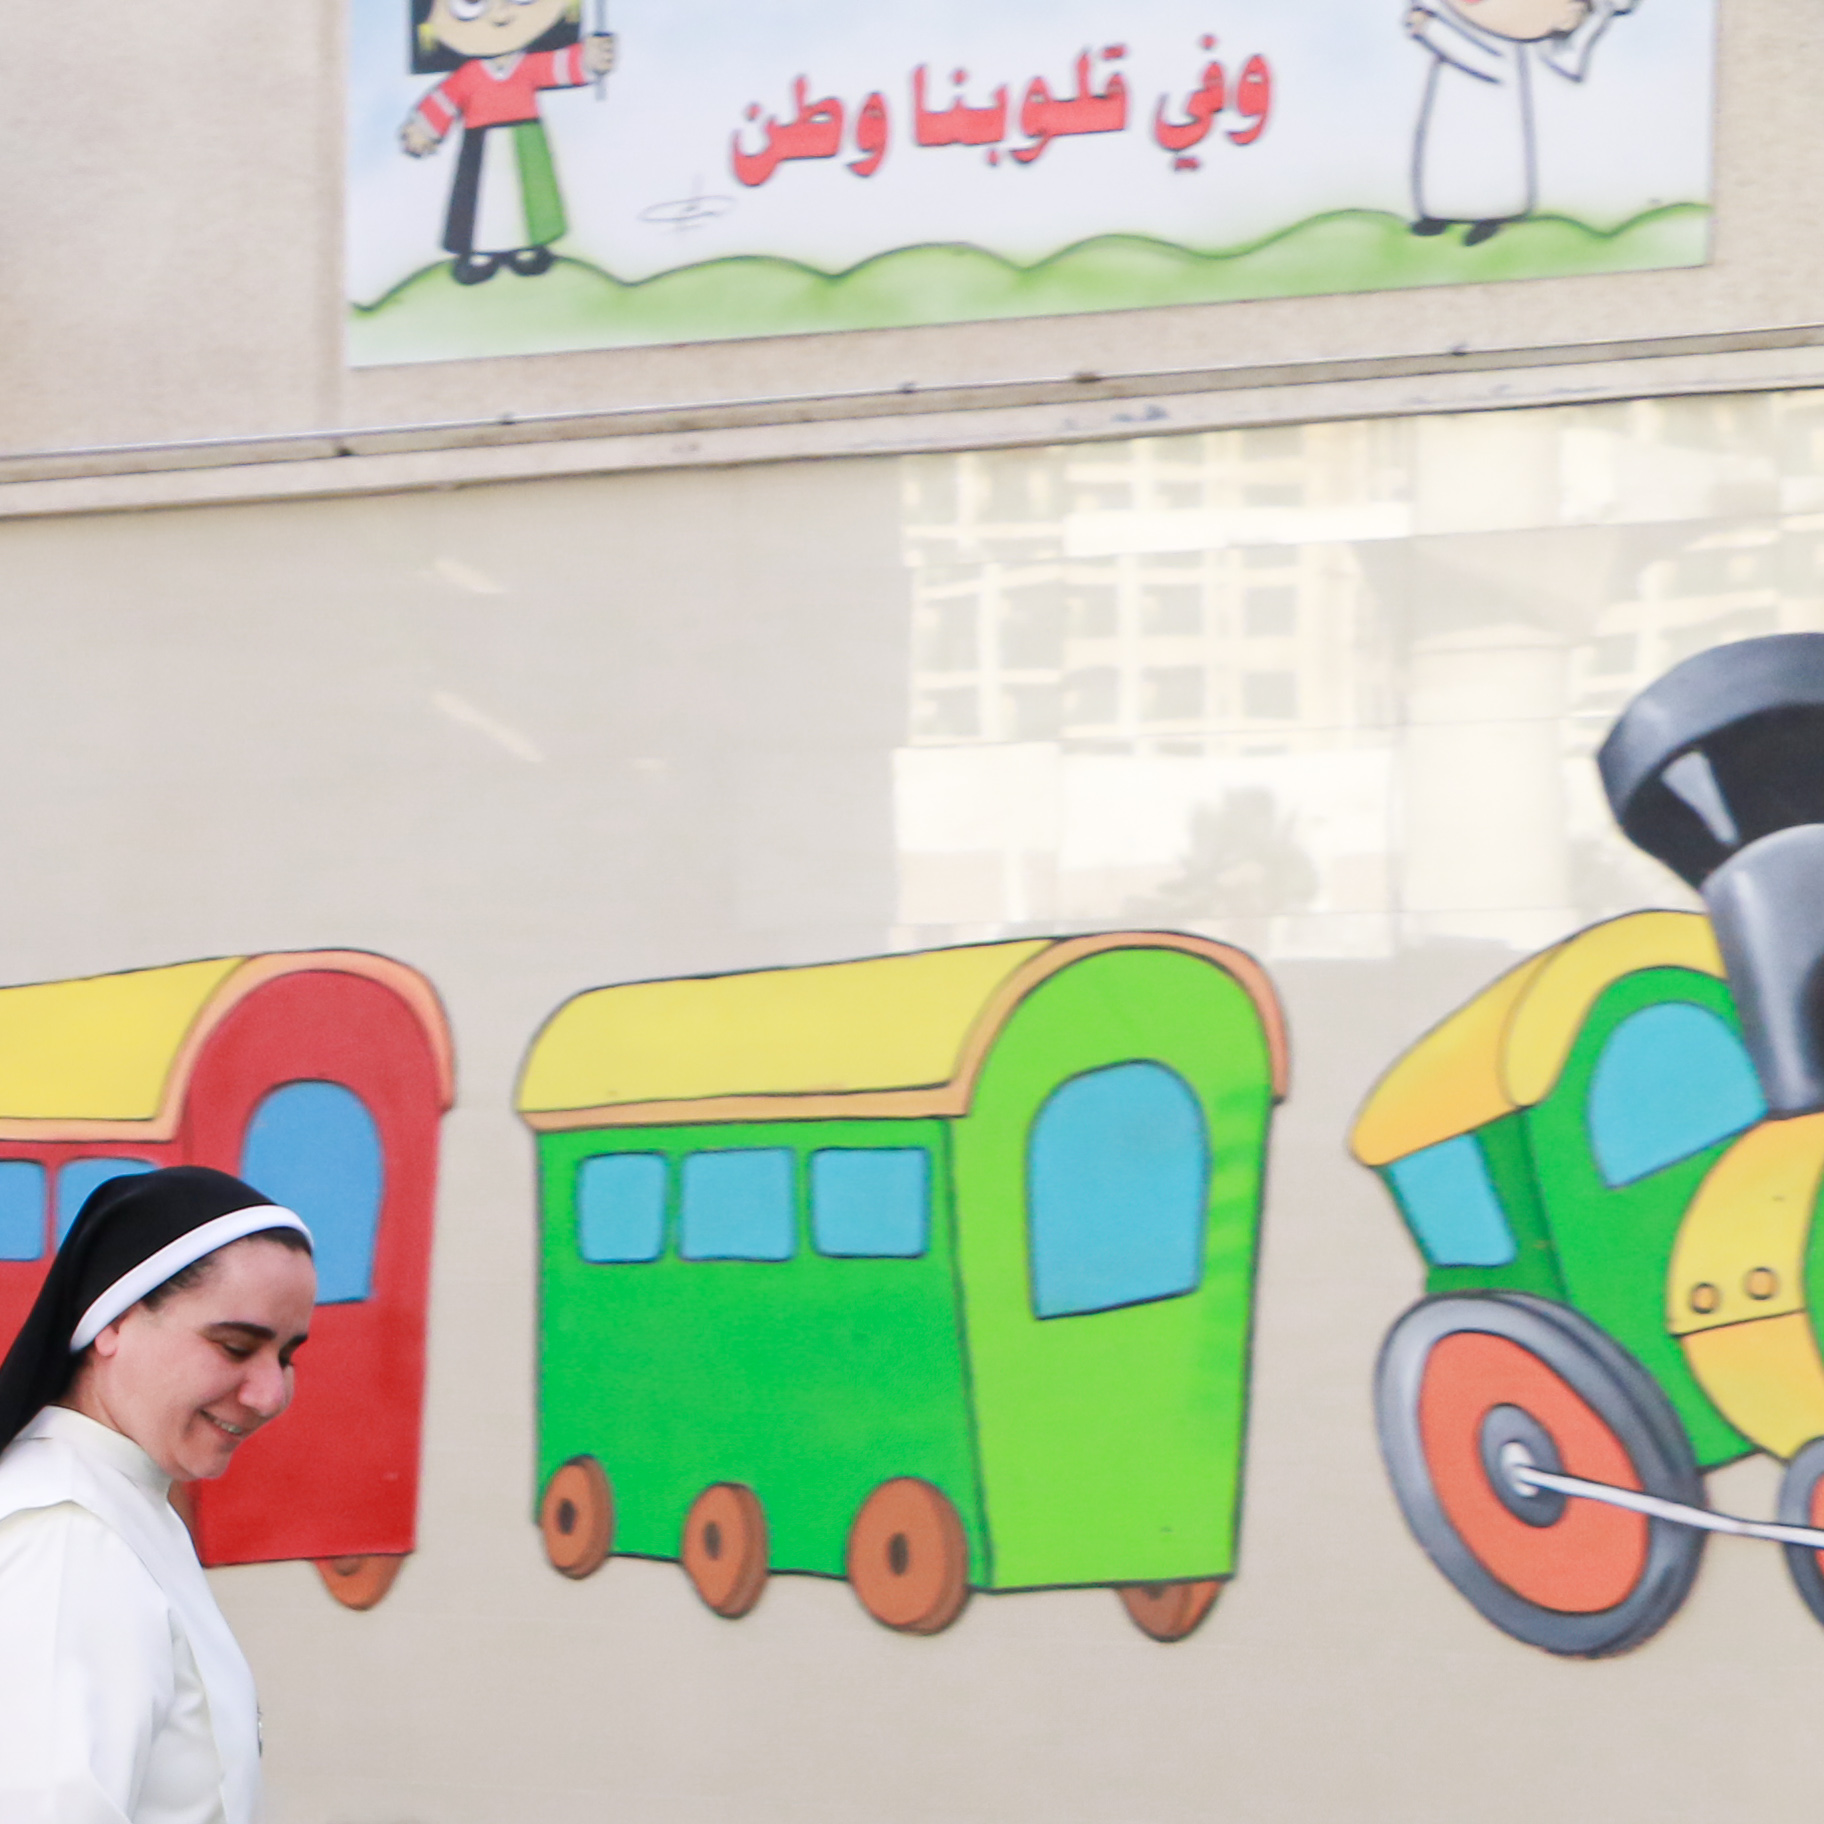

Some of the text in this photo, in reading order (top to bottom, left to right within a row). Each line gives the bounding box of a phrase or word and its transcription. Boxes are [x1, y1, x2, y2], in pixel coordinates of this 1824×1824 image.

[730, 33, 1274, 188] وفي قلوبنا وطن
